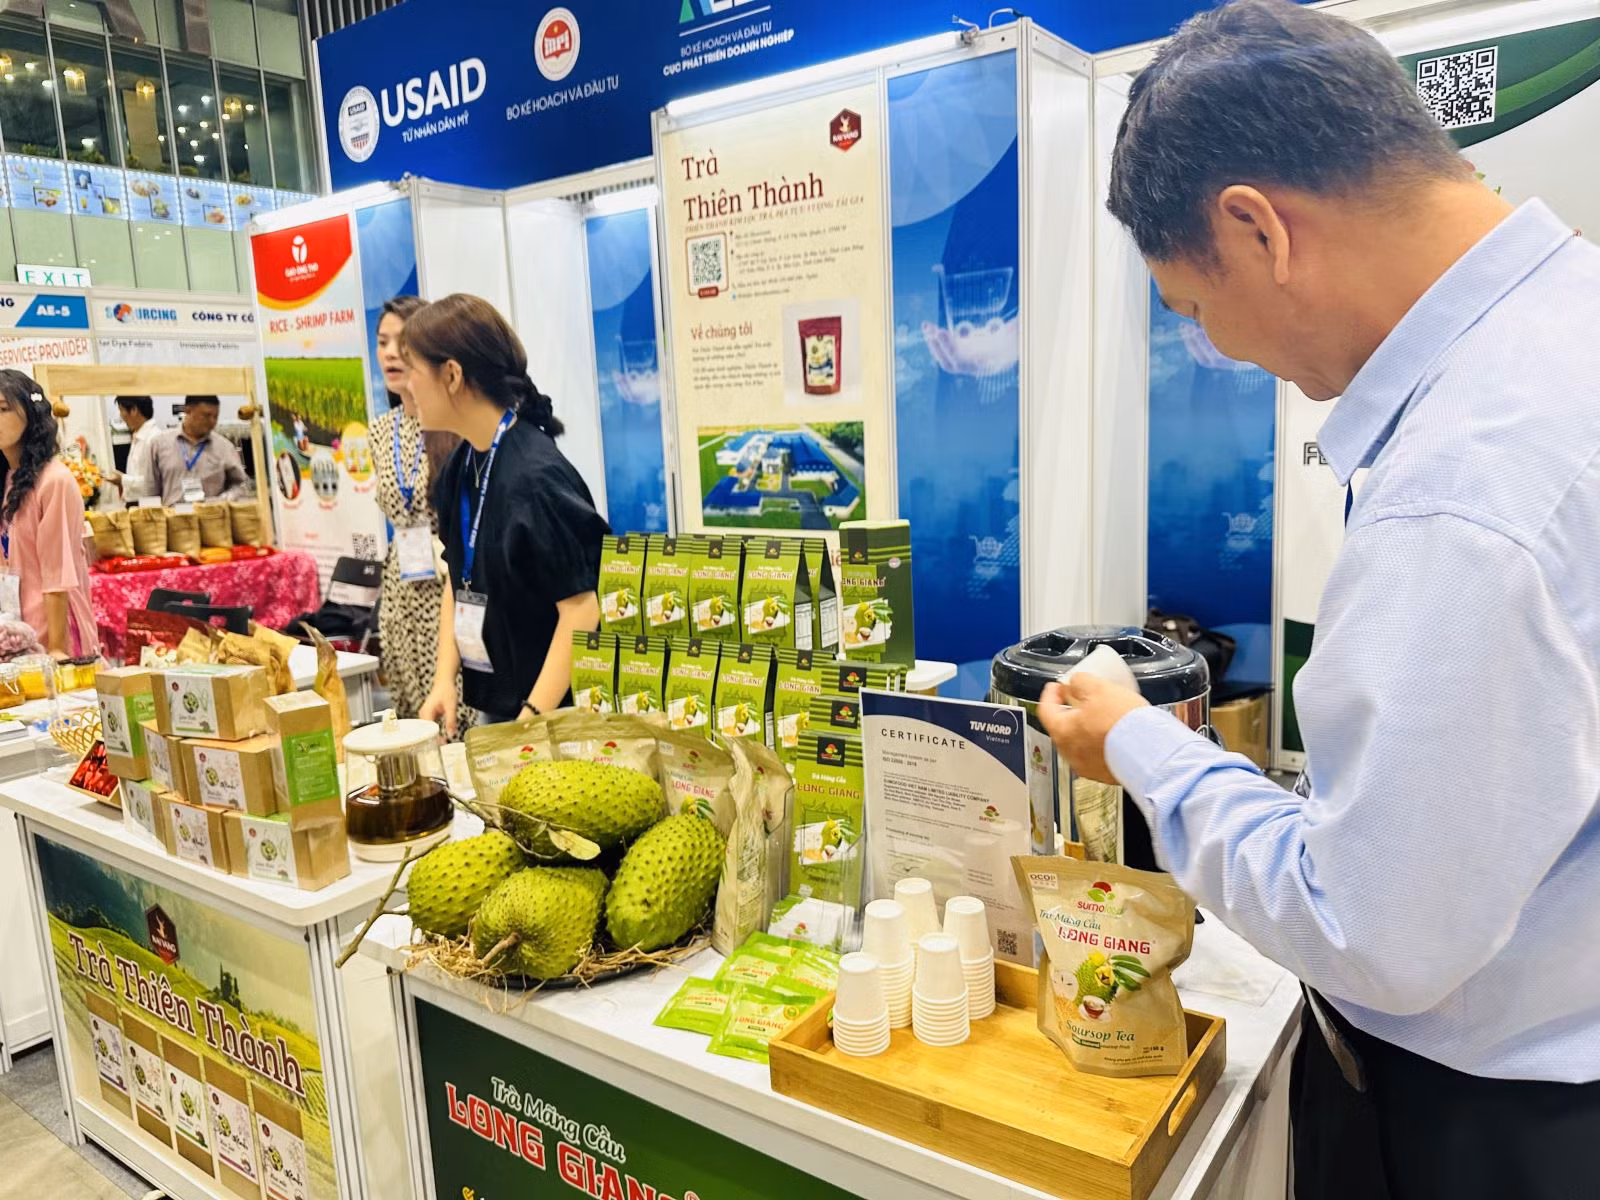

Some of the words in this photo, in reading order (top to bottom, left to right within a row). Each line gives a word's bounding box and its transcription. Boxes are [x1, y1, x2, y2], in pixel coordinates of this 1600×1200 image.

[380, 57, 487, 127] USAID
[681, 149, 719, 181] Trà
[683, 188, 742, 222] Thiên
[748, 172, 824, 210] Thành
[24, 270, 84, 286] EXIT
[801, 685, 820, 695] GIAN
[881, 728, 966, 750] CERTIFICATE
[985, 735, 1011, 745] Vietnam
[986, 723, 1012, 736] NORD
[1057, 926, 1099, 946] LONG
[1103, 936, 1150, 955] GIANG
[68, 930, 116, 992] Trà
[114, 954, 198, 1038] Thiên
[196, 996, 307, 1099] Thành
[1066, 1019, 1112, 1042] Soursop
[1115, 1030, 1135, 1041] Tea
[491, 1076, 523, 1111] Trà
[523, 1092, 581, 1146] Mãng
[582, 1123, 627, 1164] Cầu
[445, 1081, 546, 1171] LONG
[556, 1140, 676, 1200] GIAN
